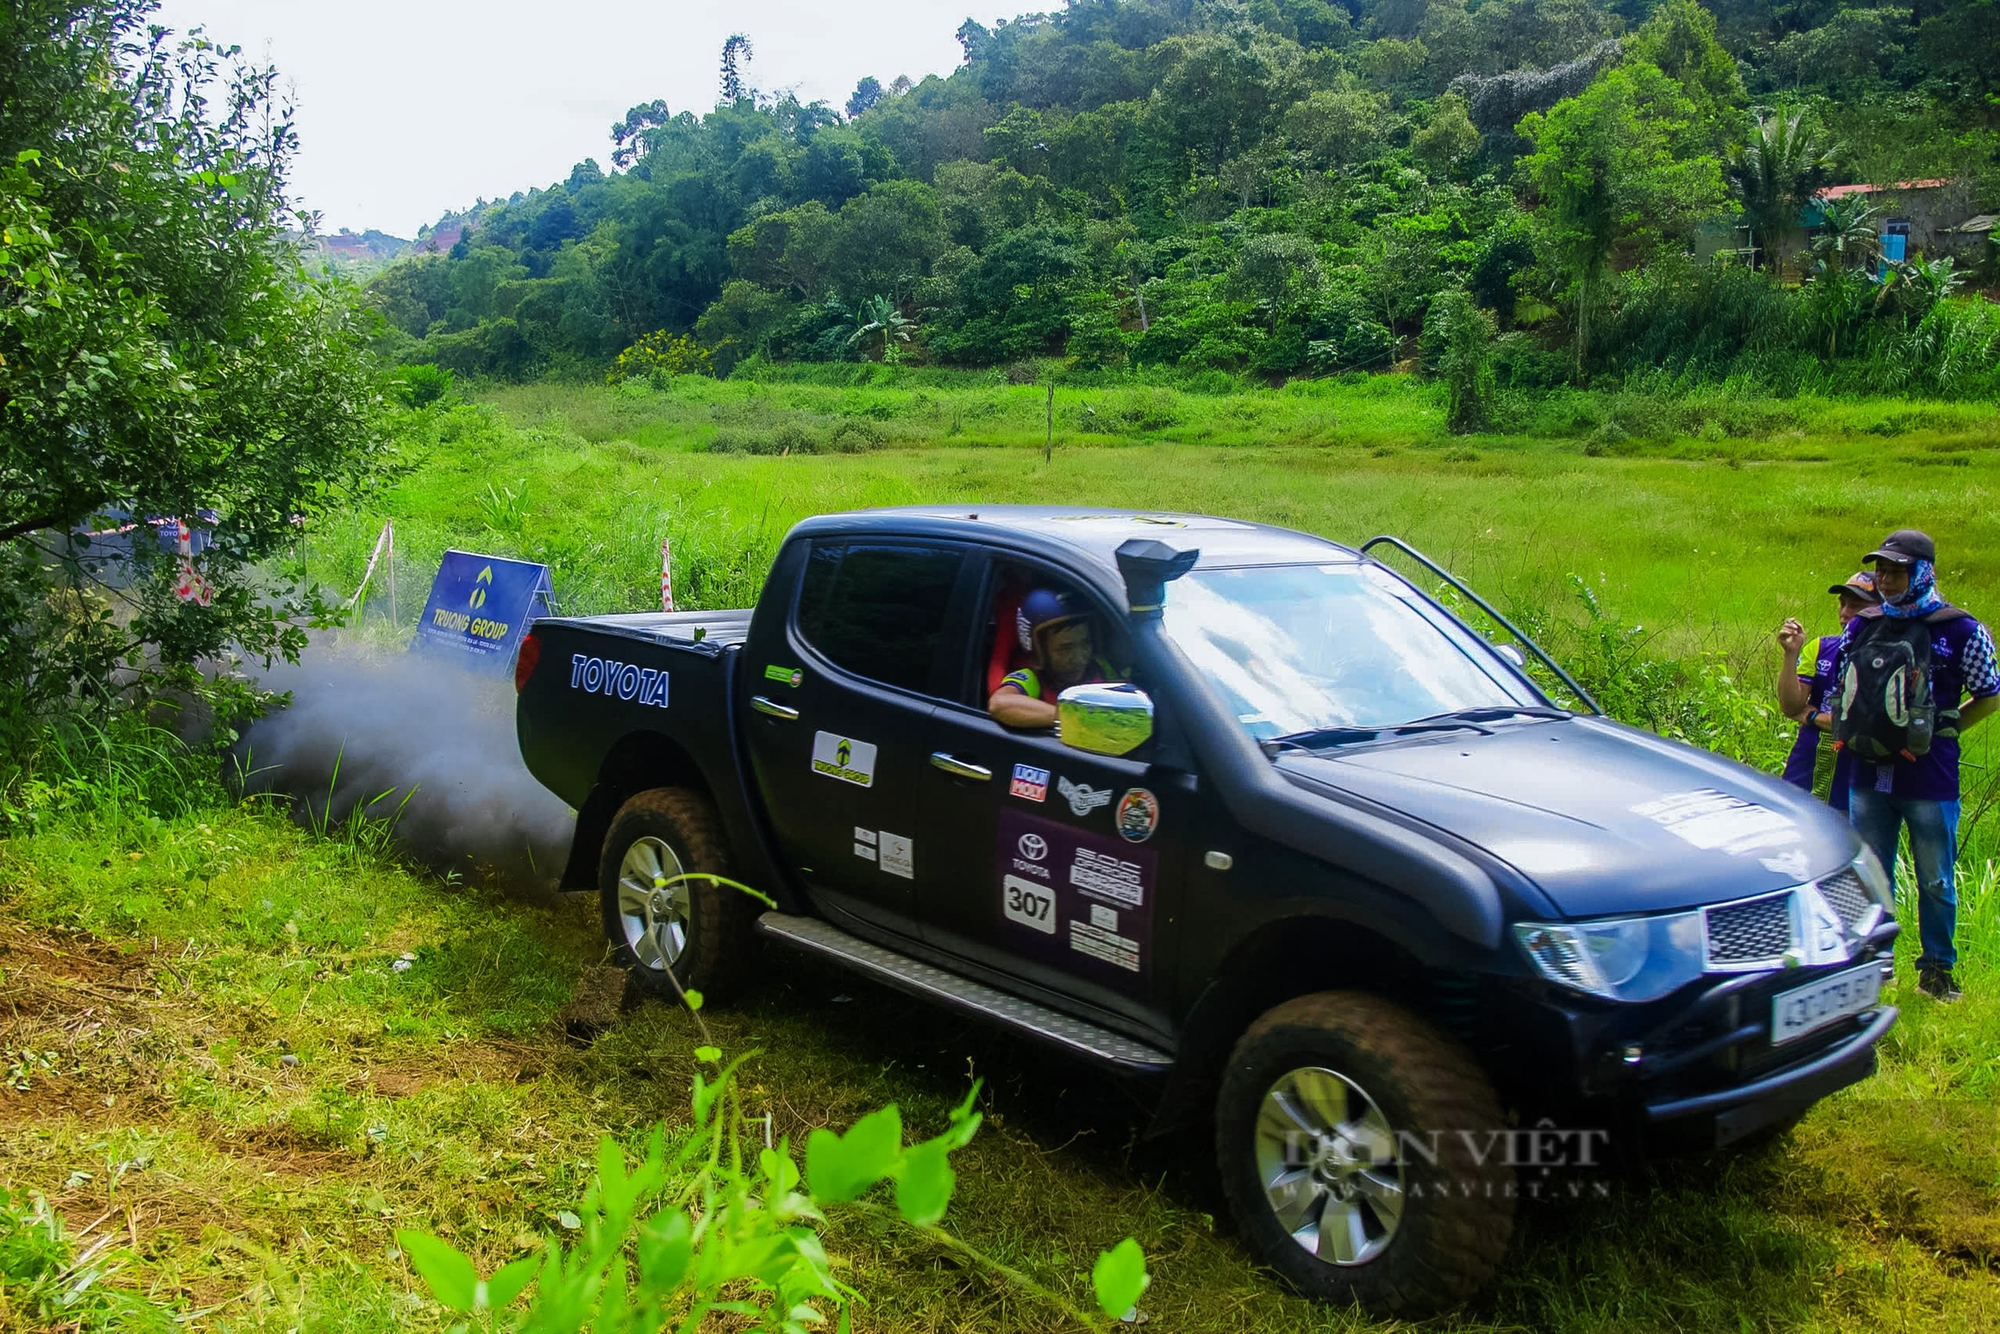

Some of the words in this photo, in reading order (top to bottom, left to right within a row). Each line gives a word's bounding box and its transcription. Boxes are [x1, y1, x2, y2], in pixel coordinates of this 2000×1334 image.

[432, 608, 470, 633] TRUONG
[471, 617, 508, 640] GROUP
[571, 653, 669, 709] TOYOTA
[1011, 780, 1046, 799] MOLY
[1012, 858, 1050, 880] TOYOTA
[1074, 857, 1141, 885] OFFROAD
[1008, 886, 1051, 922] 307
